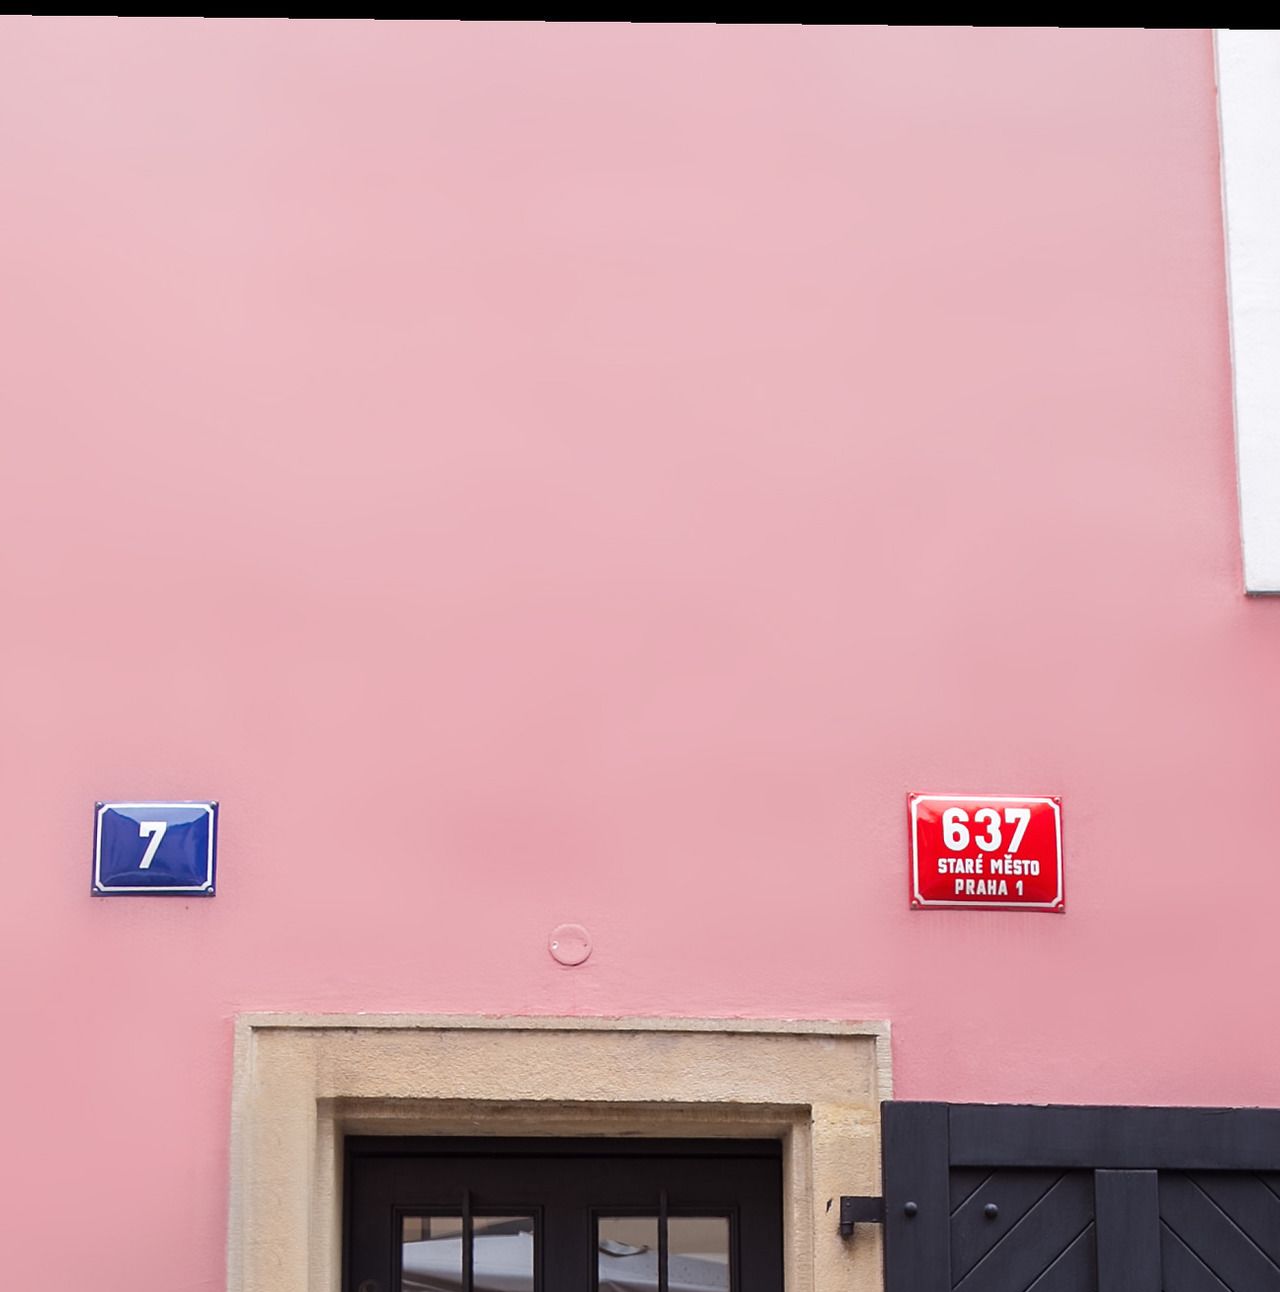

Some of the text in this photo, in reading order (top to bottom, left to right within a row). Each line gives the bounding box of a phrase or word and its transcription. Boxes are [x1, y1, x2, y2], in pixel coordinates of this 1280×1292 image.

[139, 821, 168, 869] 7
[942, 807, 1031, 853] 637
[938, 854, 1040, 876] STARÉ MĚSTO
[955, 879, 1024, 896] PRAHA 1
